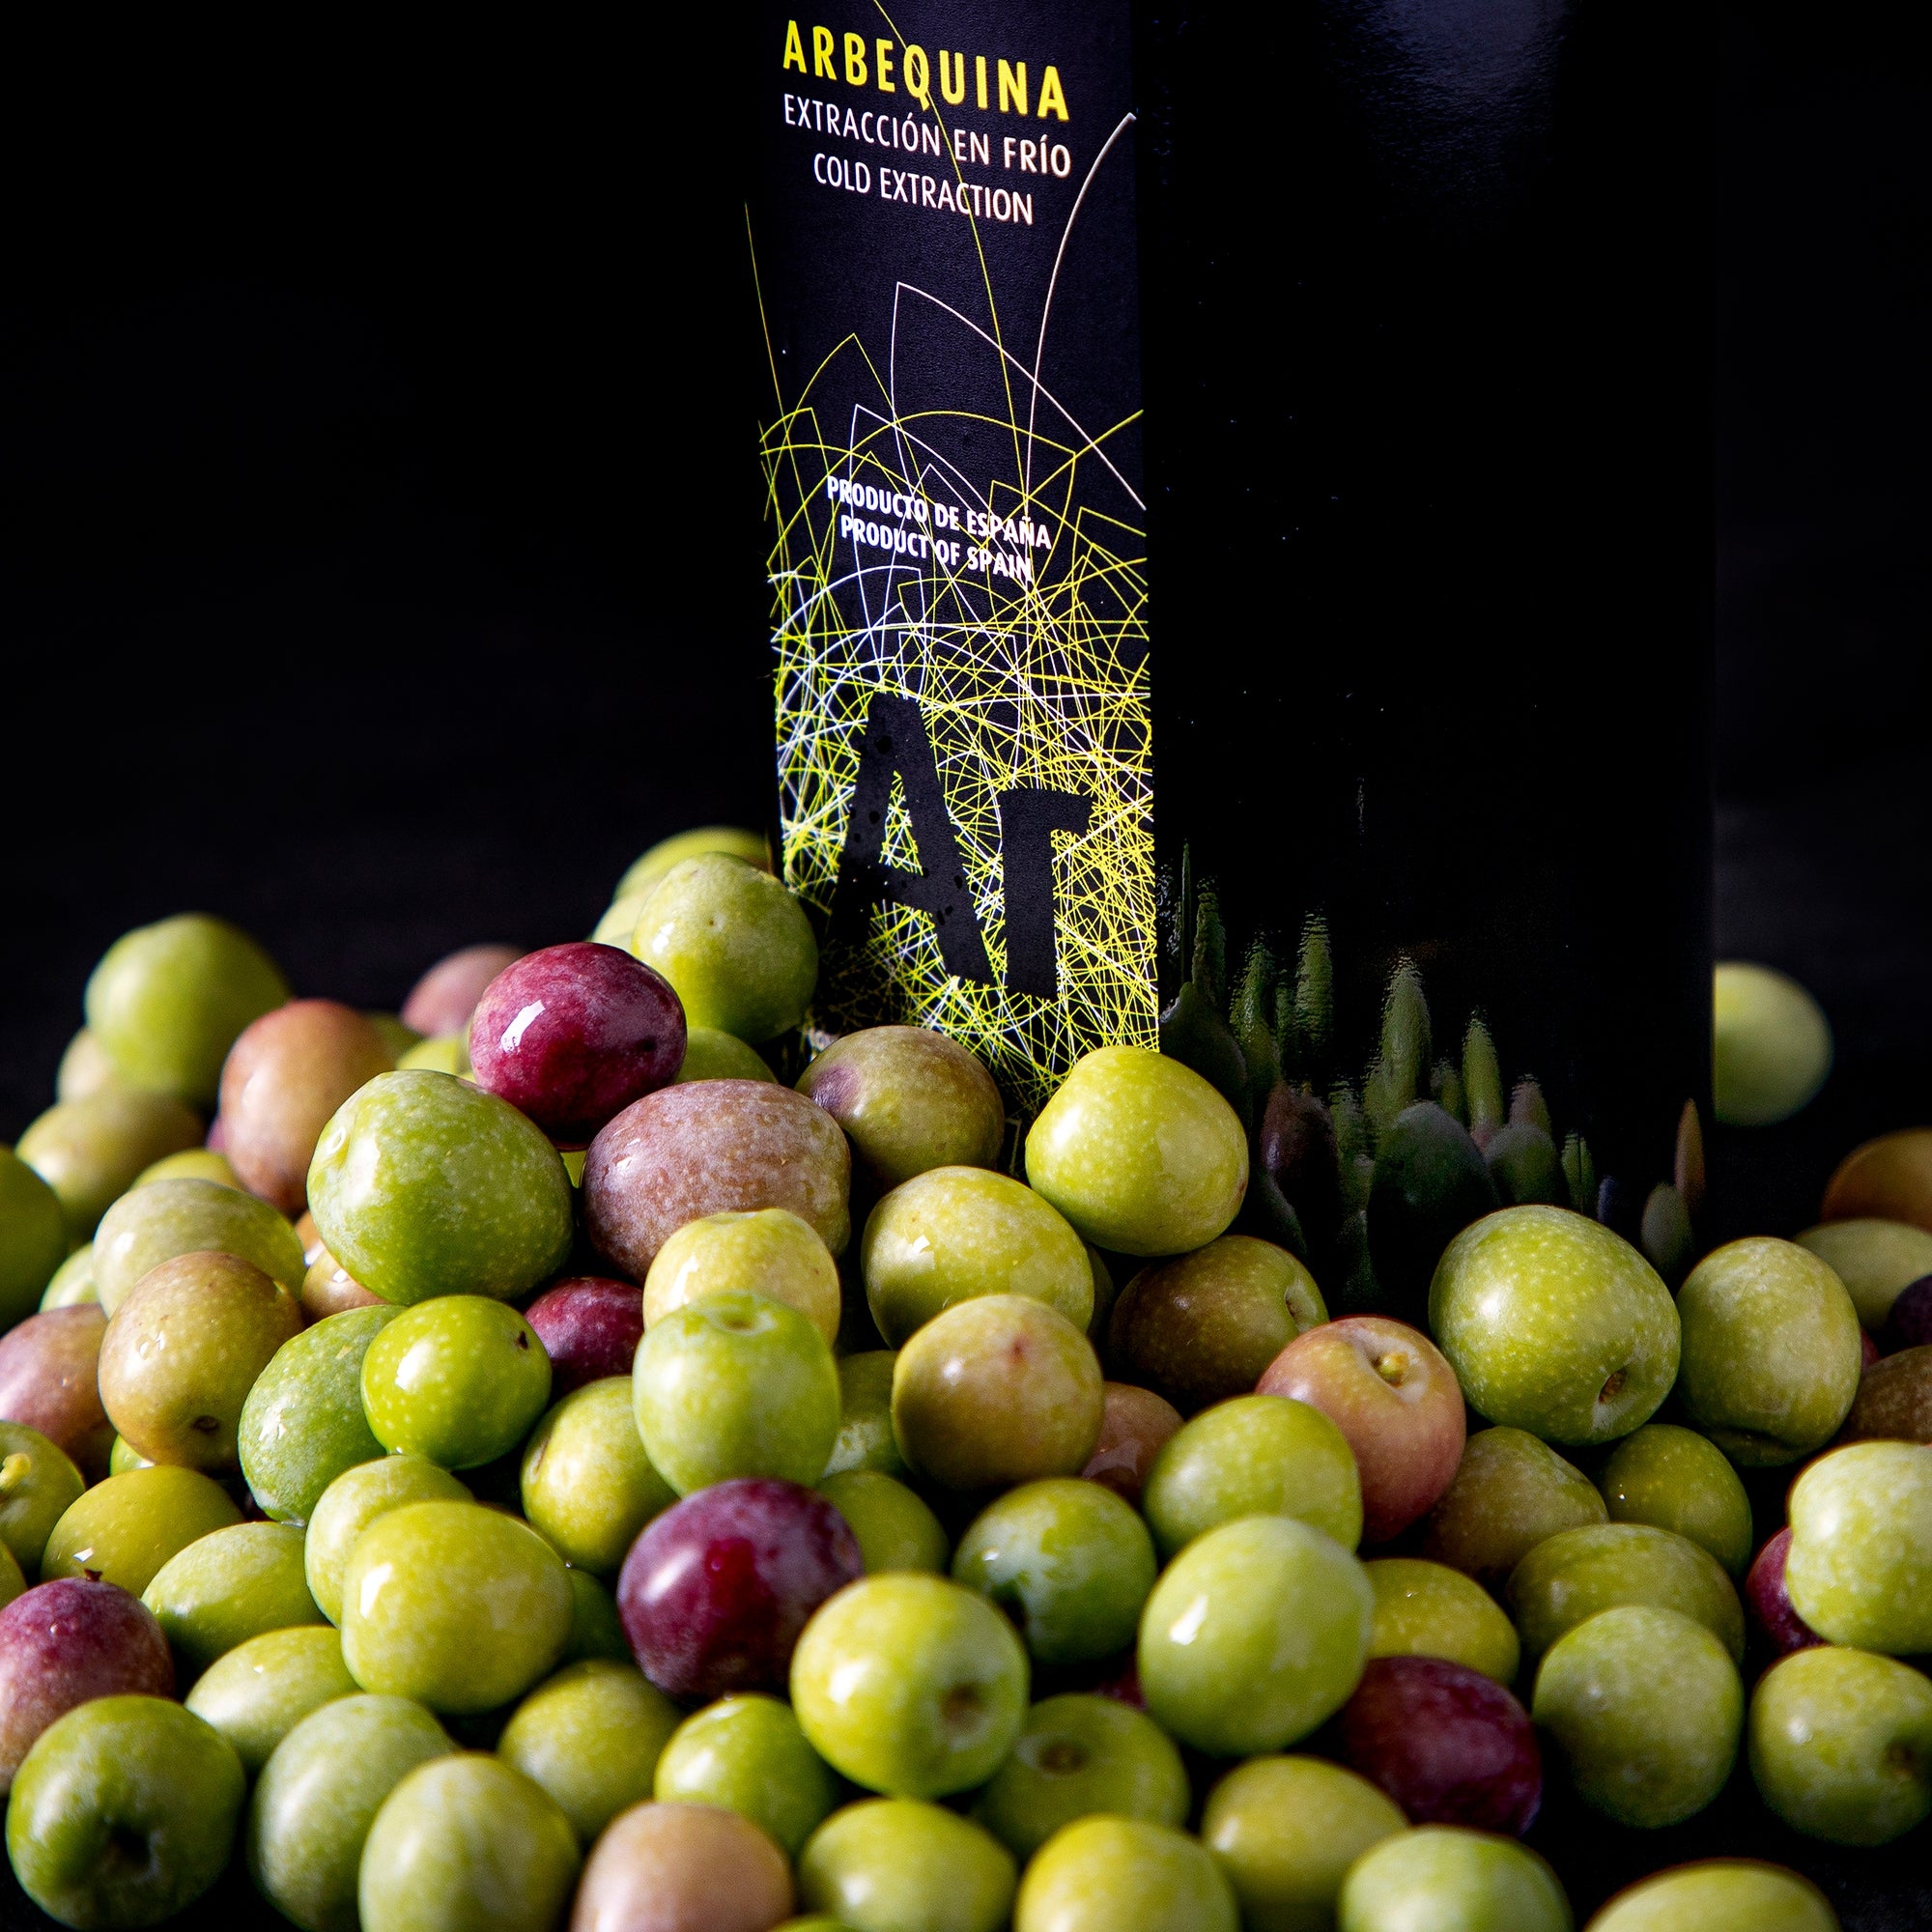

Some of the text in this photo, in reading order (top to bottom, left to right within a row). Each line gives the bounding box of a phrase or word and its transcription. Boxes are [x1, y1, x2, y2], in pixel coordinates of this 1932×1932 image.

[782, 19, 1069, 122] ARBEQUINA
[783, 93, 1071, 179] EXTRACCIÓN EN FRÍO
[813, 153, 1034, 226] COLD EXTRACTION
[826, 475, 1052, 550] PRODUCTO DE ESPAÑA
[840, 514, 1032, 581] PRODUCT OF SPAIN
